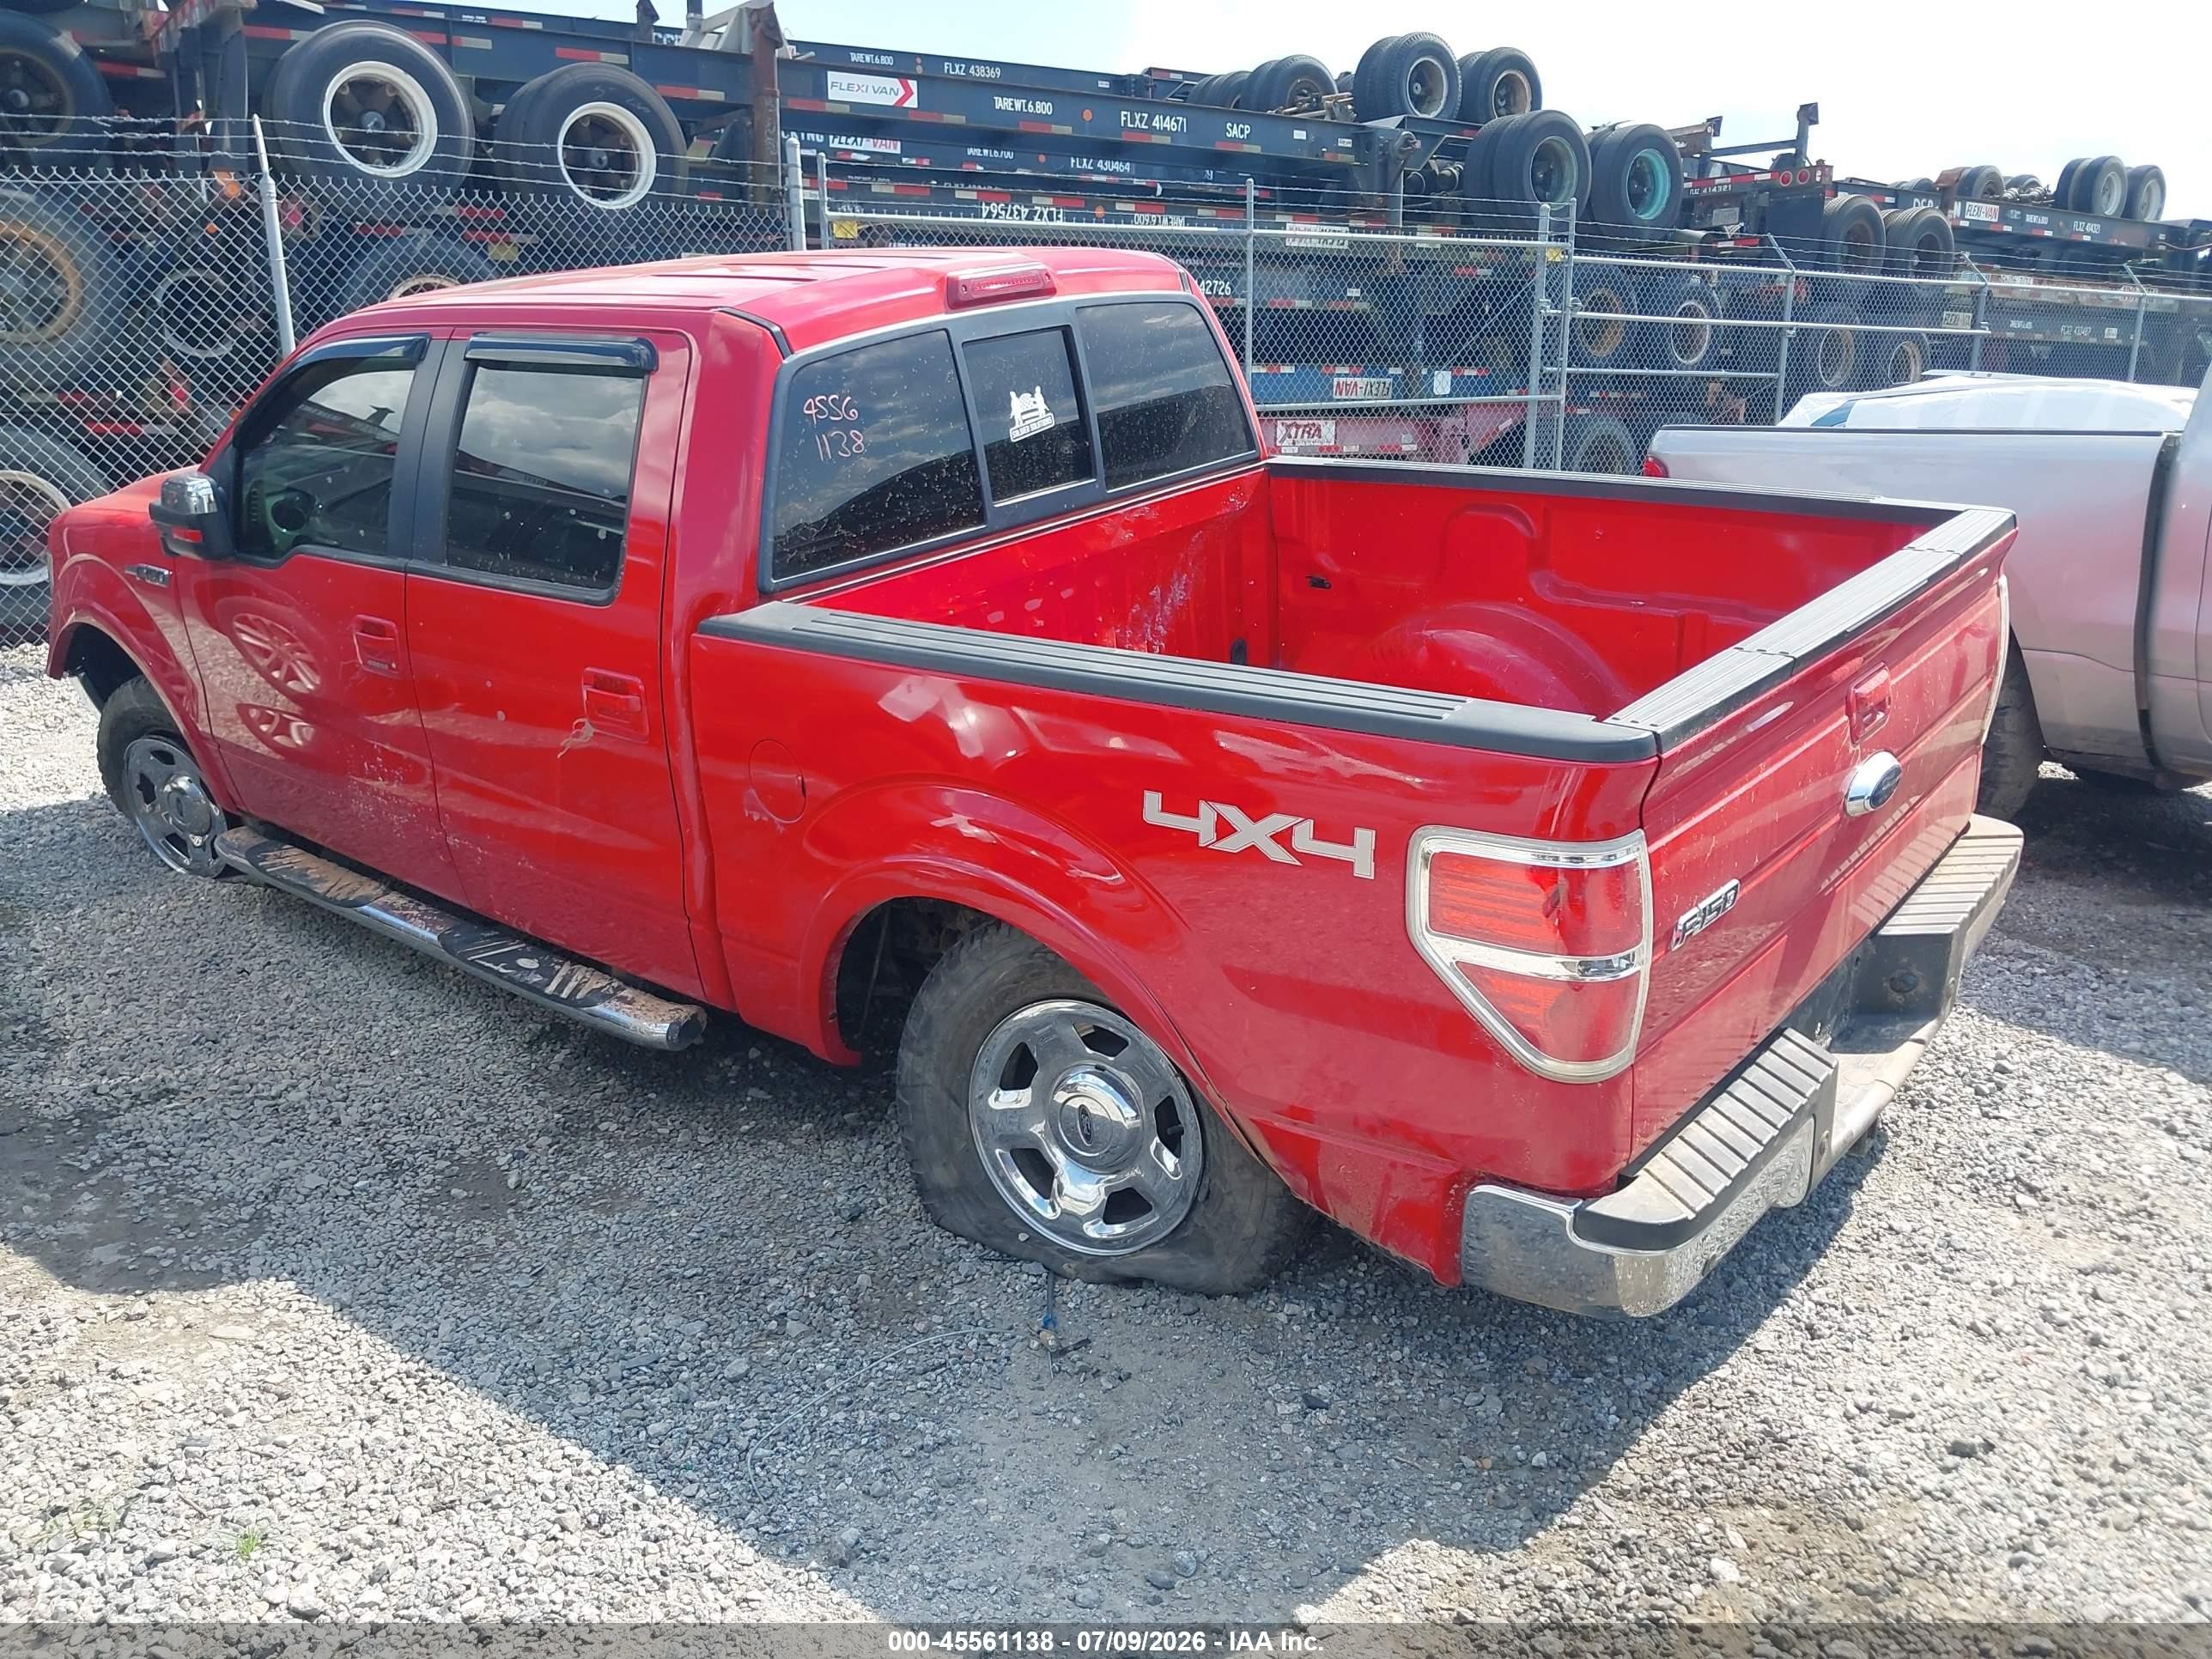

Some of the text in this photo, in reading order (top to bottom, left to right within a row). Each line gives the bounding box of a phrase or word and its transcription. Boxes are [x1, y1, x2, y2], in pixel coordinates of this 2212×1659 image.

[944, 62, 1001, 79] FLXZ 438369
[830, 81, 900, 97] FLEXI VAN
[1121, 111, 1187, 133] FLXZ 414671
[1226, 122, 1250, 139] SACP
[1097, 159, 1130, 173] 430464
[981, 201, 1064, 223] FLXZ 437564
[1966, 204, 1998, 221] FLEXI-VAN
[1334, 380, 1391, 398] FLEXI-VAN
[815, 430, 865, 461] 1138
